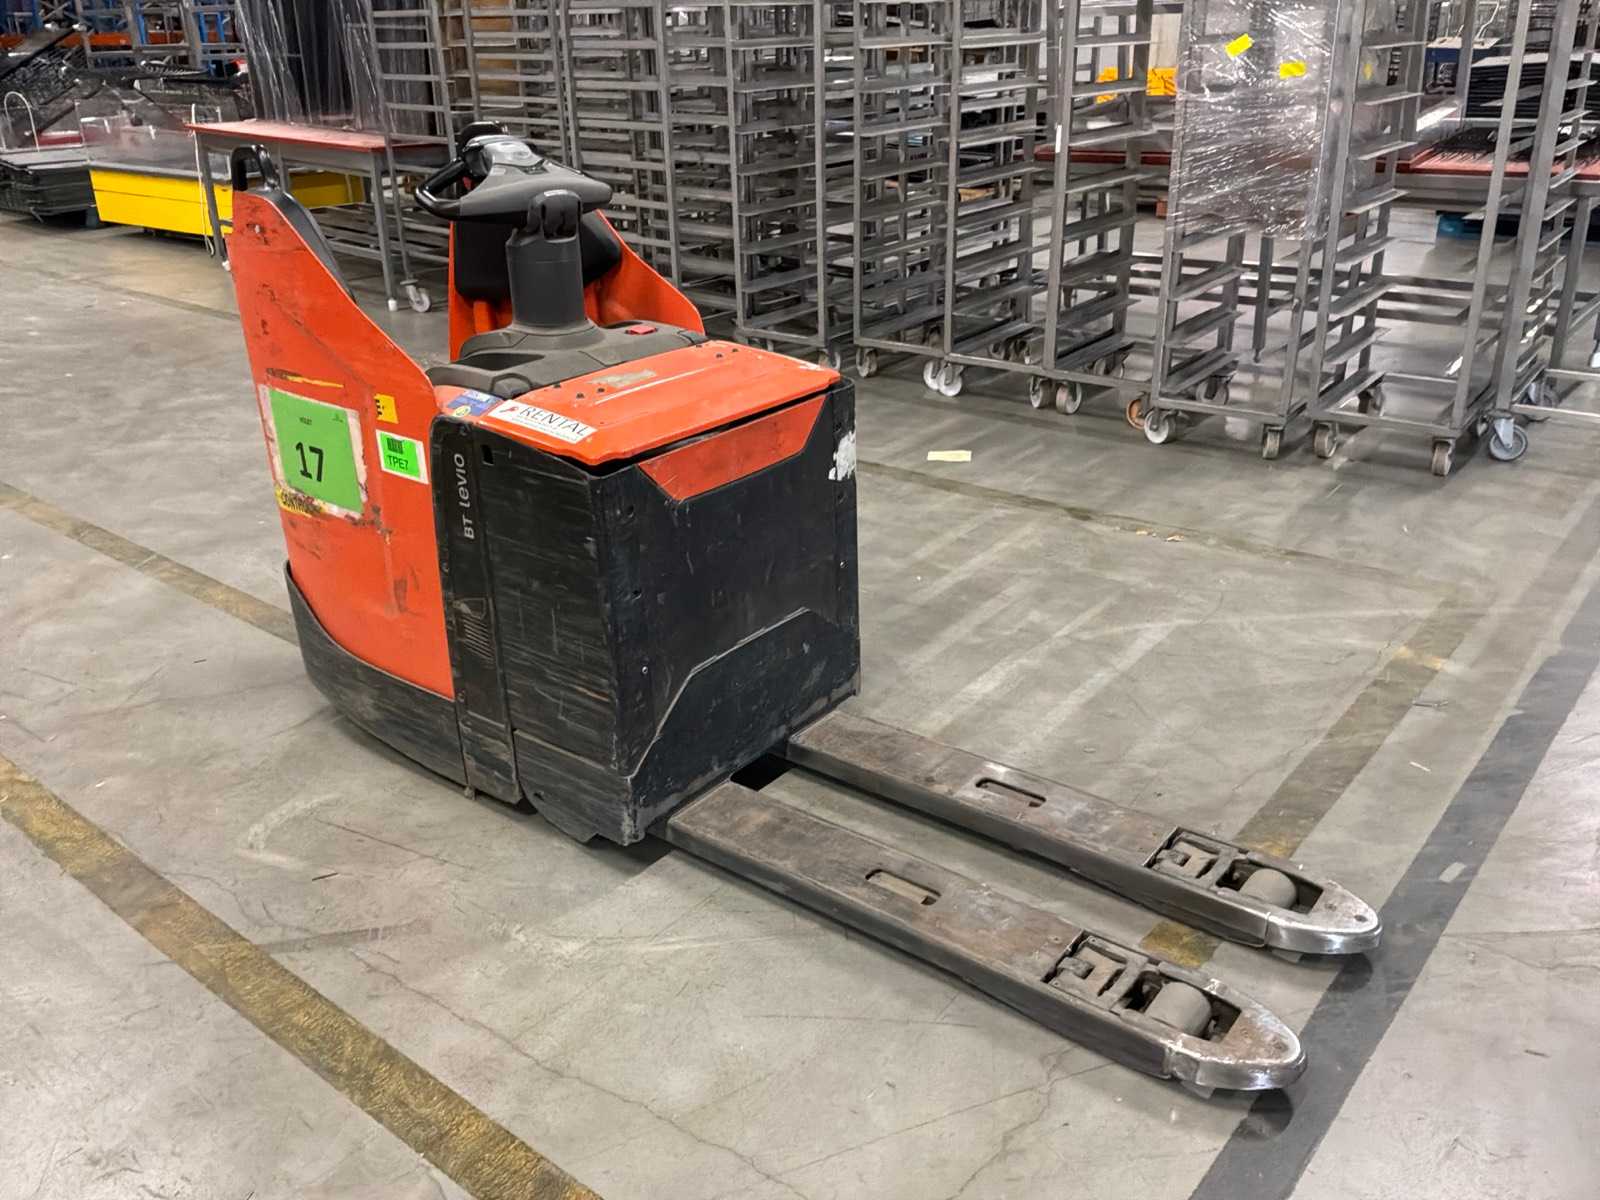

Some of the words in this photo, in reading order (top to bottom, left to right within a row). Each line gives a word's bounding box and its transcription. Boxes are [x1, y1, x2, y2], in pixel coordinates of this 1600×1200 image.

[520, 406, 588, 436] RENTAL
[296, 442, 323, 482] 17
[462, 514, 475, 540] BT
